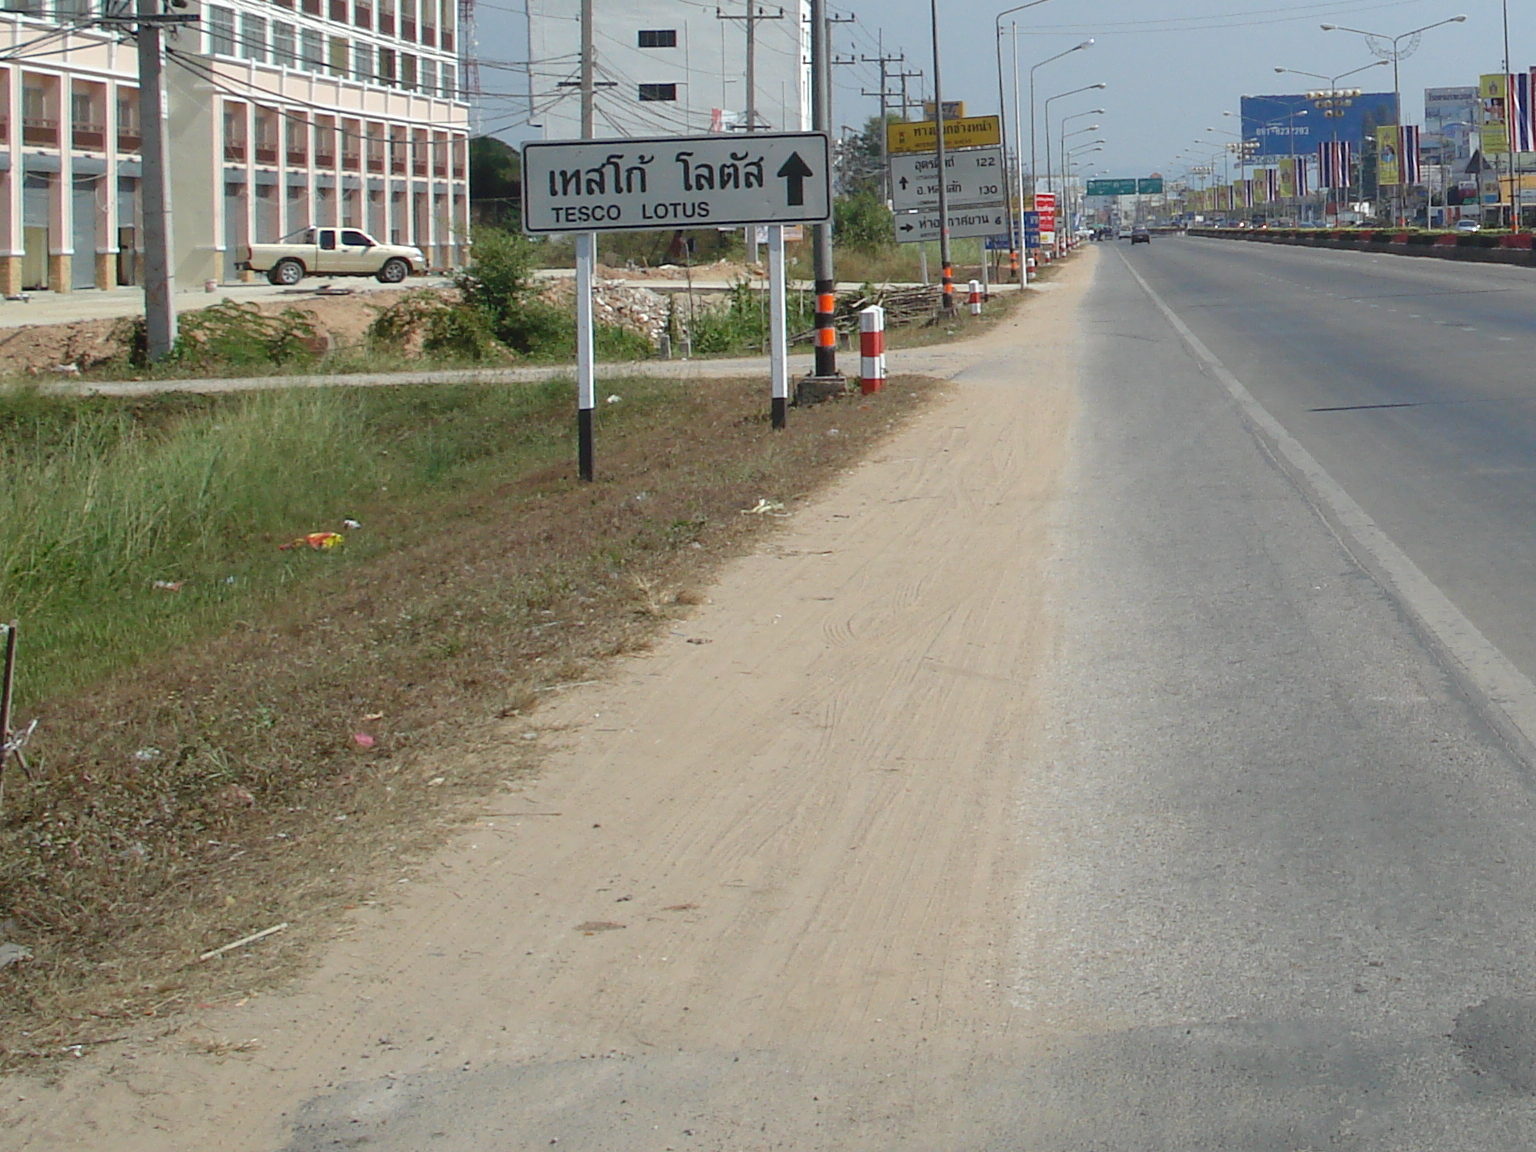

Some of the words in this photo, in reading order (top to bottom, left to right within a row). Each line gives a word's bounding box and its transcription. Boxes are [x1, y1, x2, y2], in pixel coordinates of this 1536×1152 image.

[975, 156, 996, 168] 122
[548, 154, 655, 197] เทสโก้
[675, 150, 765, 192] โลตัส
[978, 184, 998, 196] 130
[551, 204, 622, 223] TESCO
[641, 201, 711, 221] LOTUS
